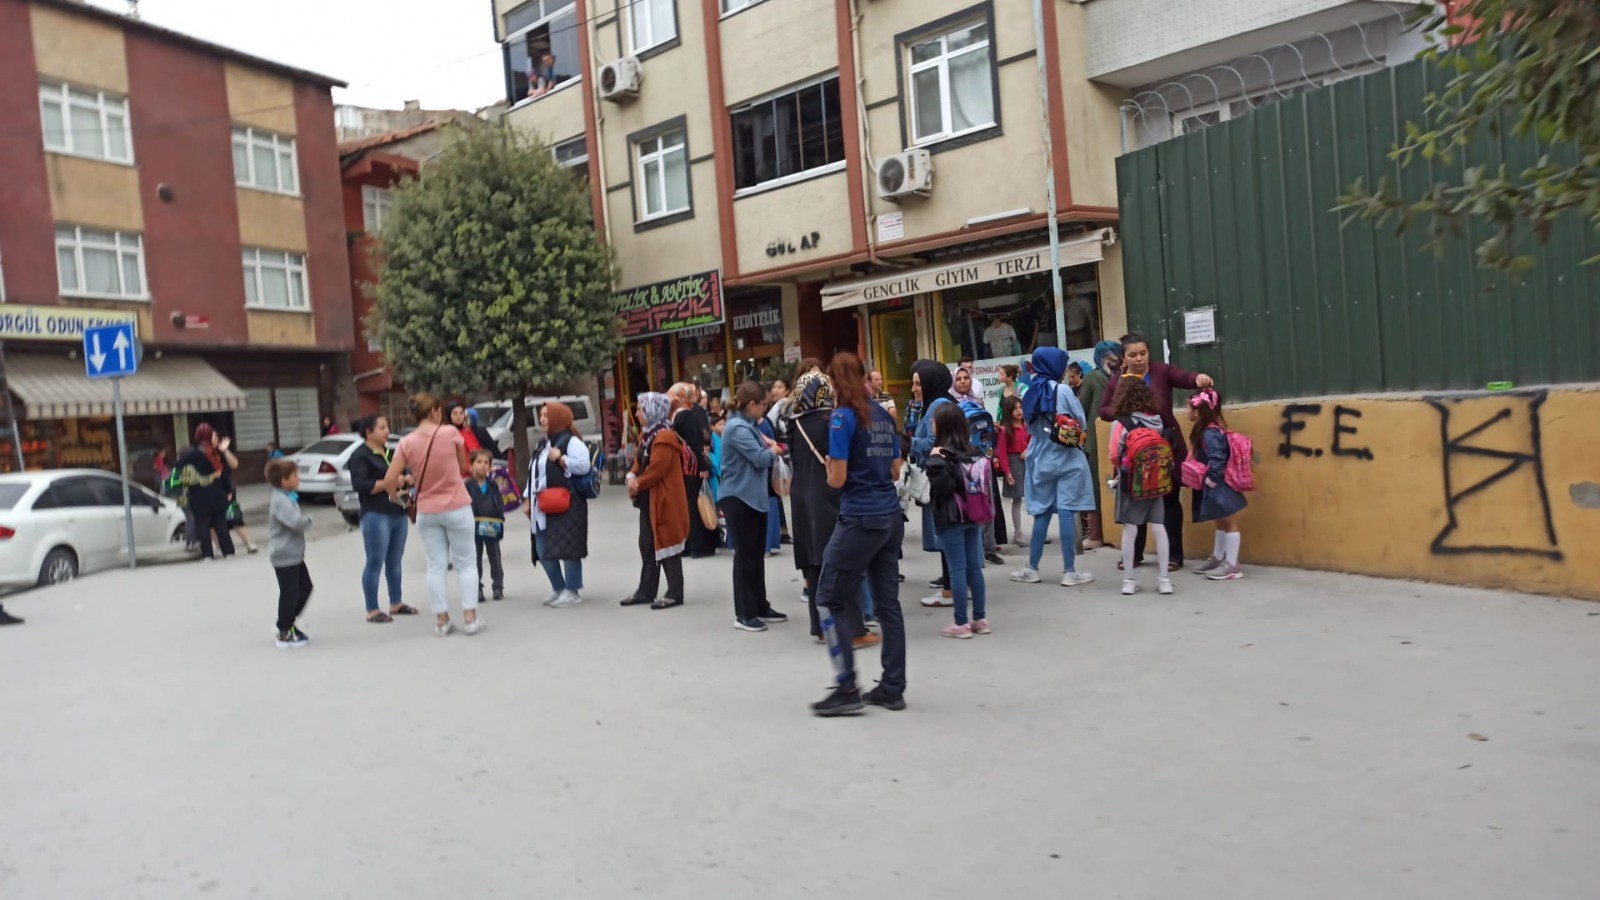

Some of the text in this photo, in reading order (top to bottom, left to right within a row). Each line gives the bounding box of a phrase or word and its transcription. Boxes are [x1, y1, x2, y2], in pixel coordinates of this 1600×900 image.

[935, 267, 979, 287] GİYİM
[995, 253, 1041, 275] TERZİ
[732, 305, 780, 330] HEDİYELİK
